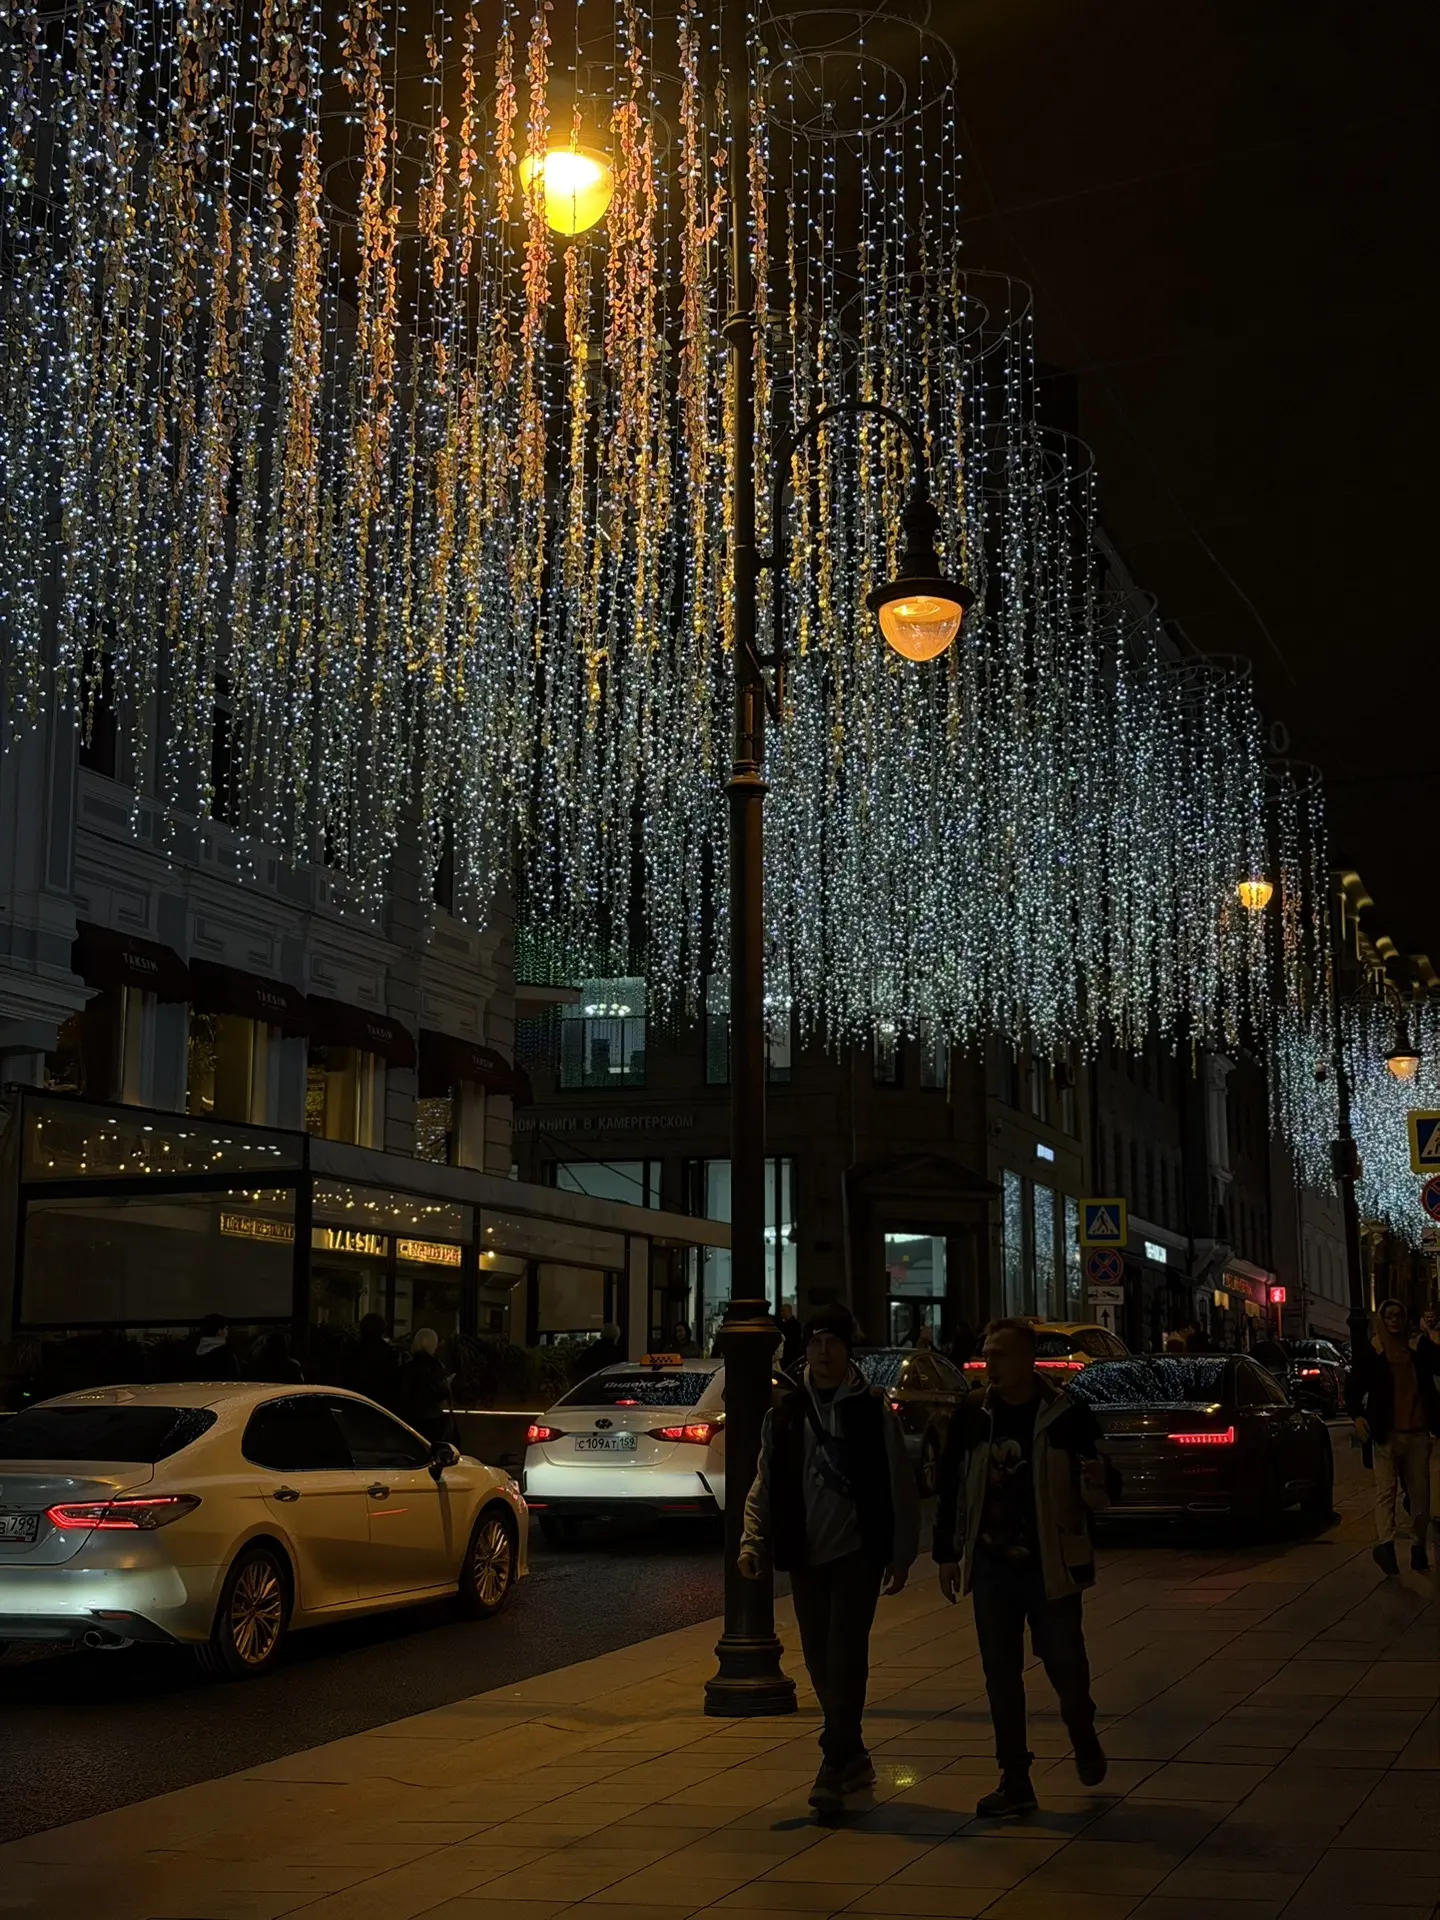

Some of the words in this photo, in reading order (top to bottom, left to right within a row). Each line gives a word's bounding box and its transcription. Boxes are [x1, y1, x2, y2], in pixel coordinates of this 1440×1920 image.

[539, 1117, 577, 1131] КНИГИ
[583, 1117, 592, 1130] В
[599, 1114, 694, 1129] КАМЕРГЕРСКОМ
[619, 1438, 635, 1447] 159
[10, 1517, 34, 1530] 799
